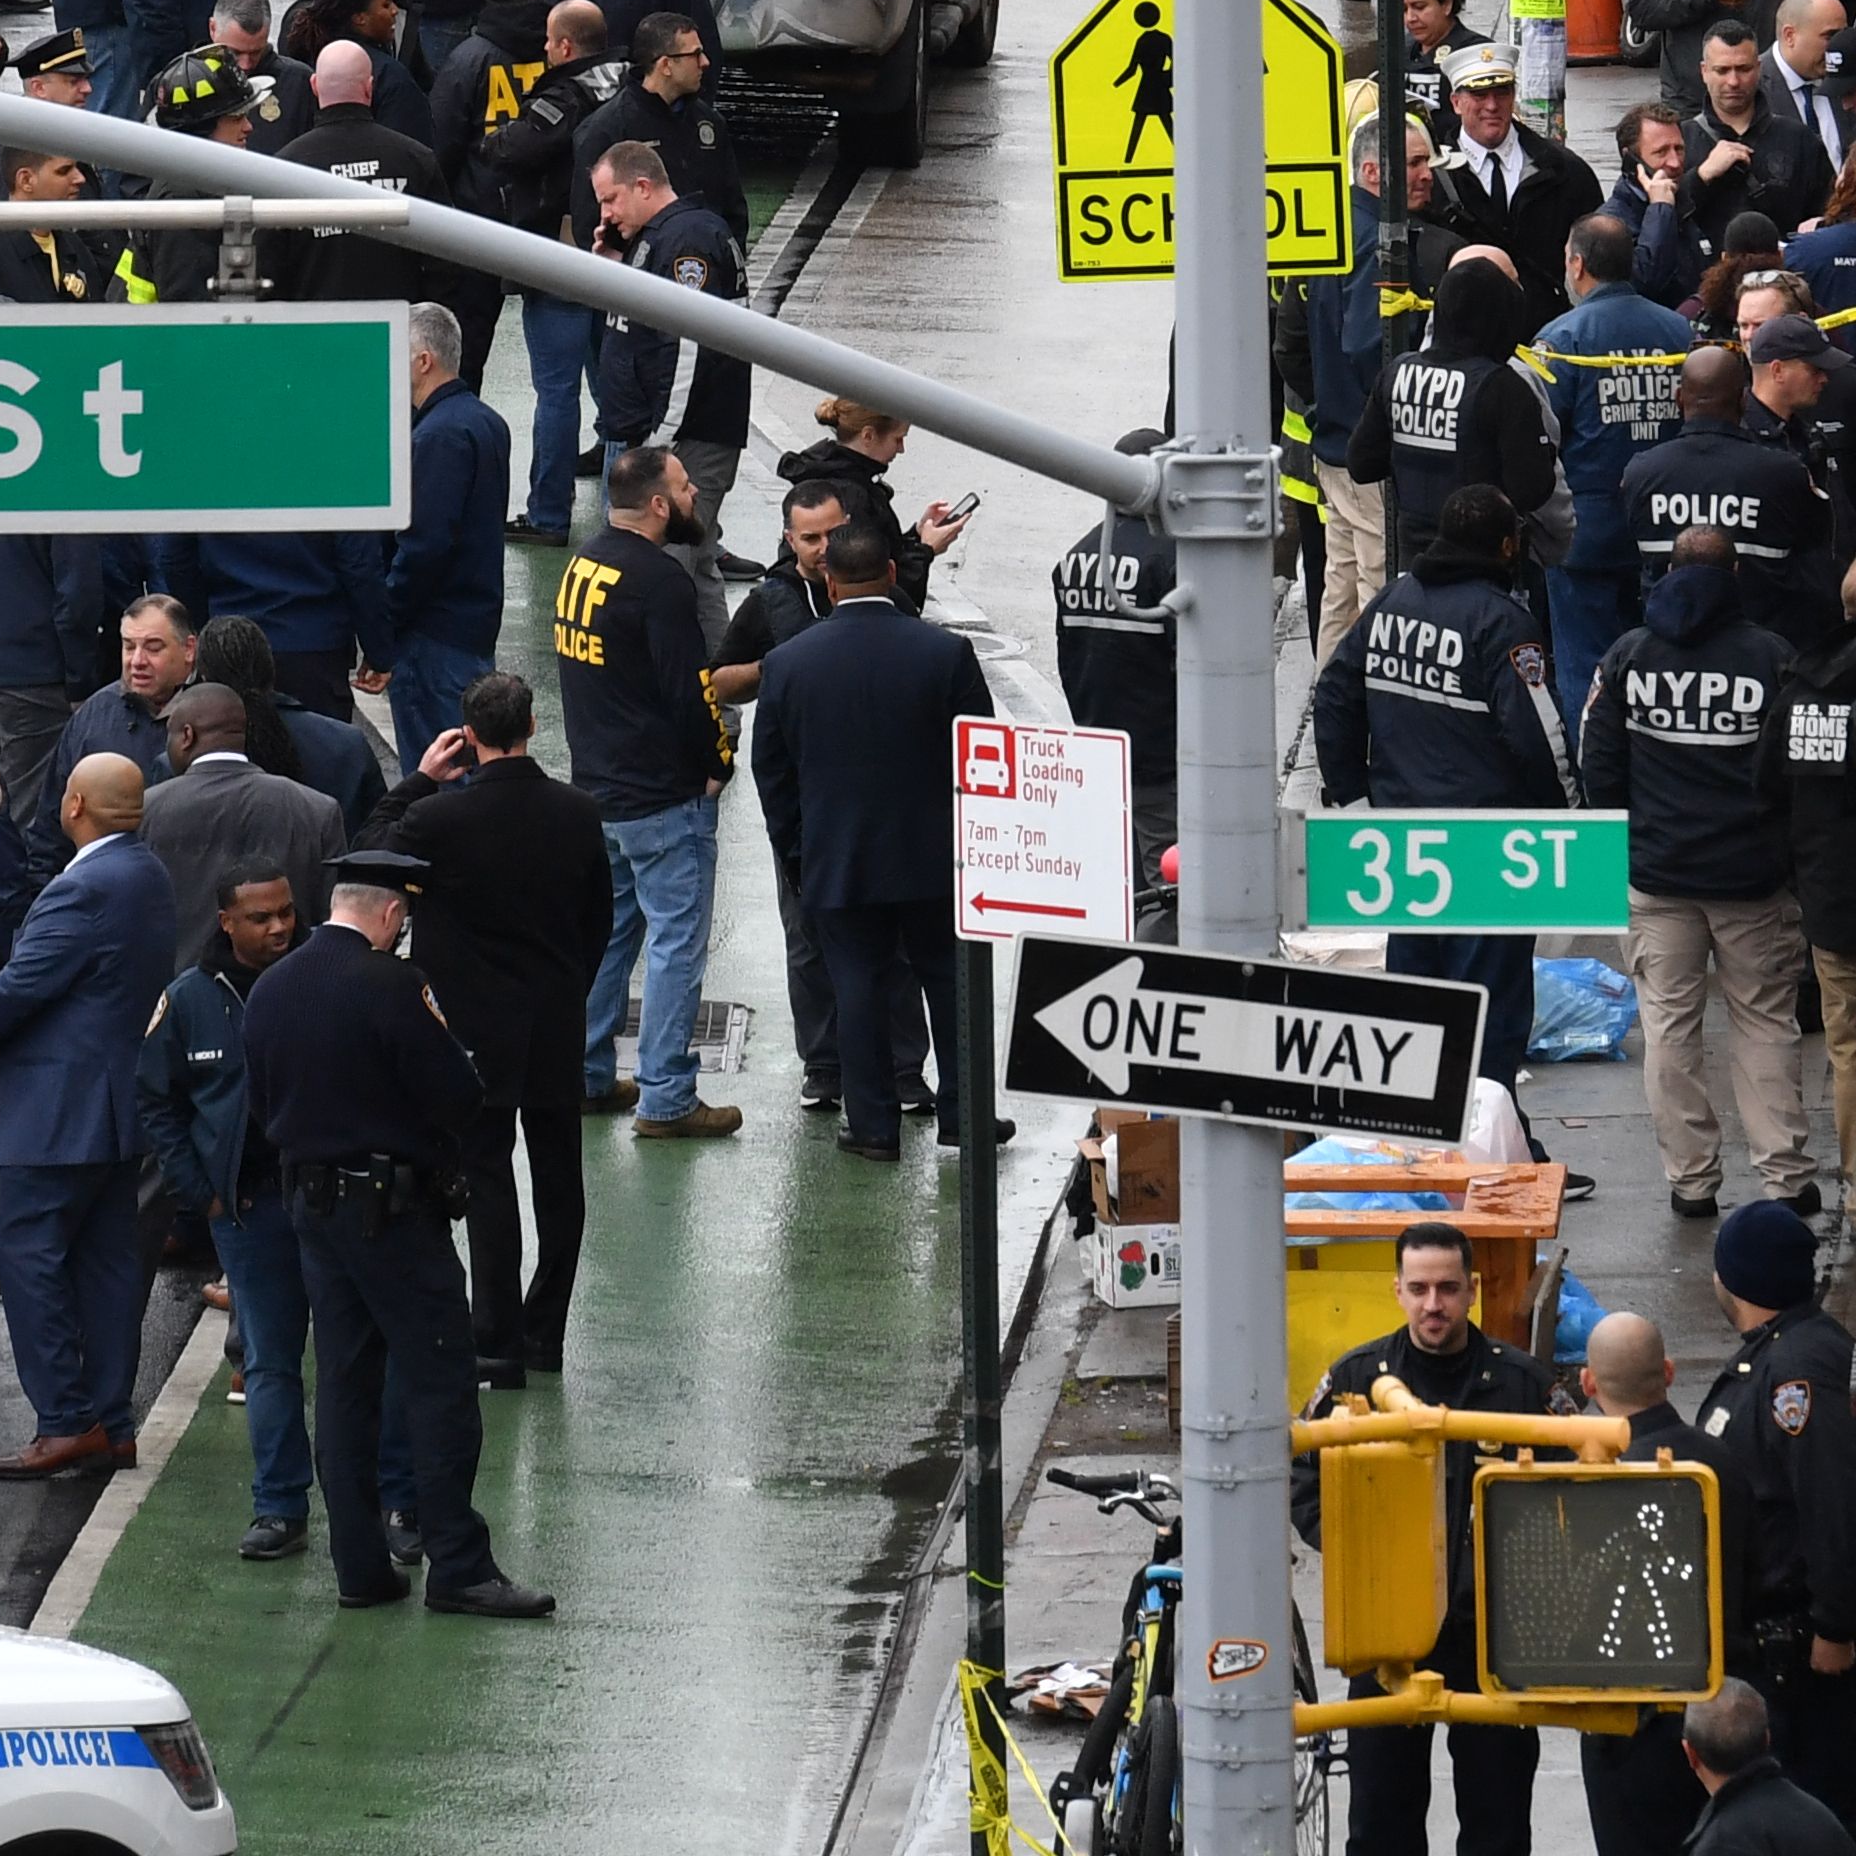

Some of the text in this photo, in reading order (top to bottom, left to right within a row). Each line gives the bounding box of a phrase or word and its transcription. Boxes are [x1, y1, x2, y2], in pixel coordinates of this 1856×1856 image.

[484, 61, 546, 123] AT
[330, 161, 380, 181] CHIEF
[1390, 362, 1465, 410] NYPD
[1597, 372, 1683, 407] POLICE
[1390, 404, 1459, 441] POLICE
[1600, 402, 1682, 423] CRIME SCENE
[1629, 420, 1660, 442] UNIT
[1650, 493, 1761, 530] POLICE
[1056, 552, 1140, 593] NYPD
[1058, 584, 1136, 613] POLICE
[1368, 611, 1465, 668] NYPD
[1365, 652, 1463, 695] POLICE
[1626, 669, 1766, 713] NYPD
[1632, 708, 1762, 734] POLICE
[1792, 703, 1823, 716] U.S.
[1789, 715, 1848, 739] HOME
[1021, 736, 1066, 759] Truck
[1788, 738, 1848, 763] SECU
[1021, 757, 1084, 788] Loading
[1021, 783, 1058, 810] Only
[966, 820, 998, 842] 7am
[1014, 824, 1047, 848] 7pm
[966, 847, 1082, 882] Except Sunday
[1345, 827, 1580, 918] 35 ST
[1081, 993, 1415, 1087] ONE WAY
[1266, 1106, 1298, 1118] DEPT
[1337, 1115, 1444, 1137] TRANSPORTATION
[7, 1730, 111, 1769] POLICE
